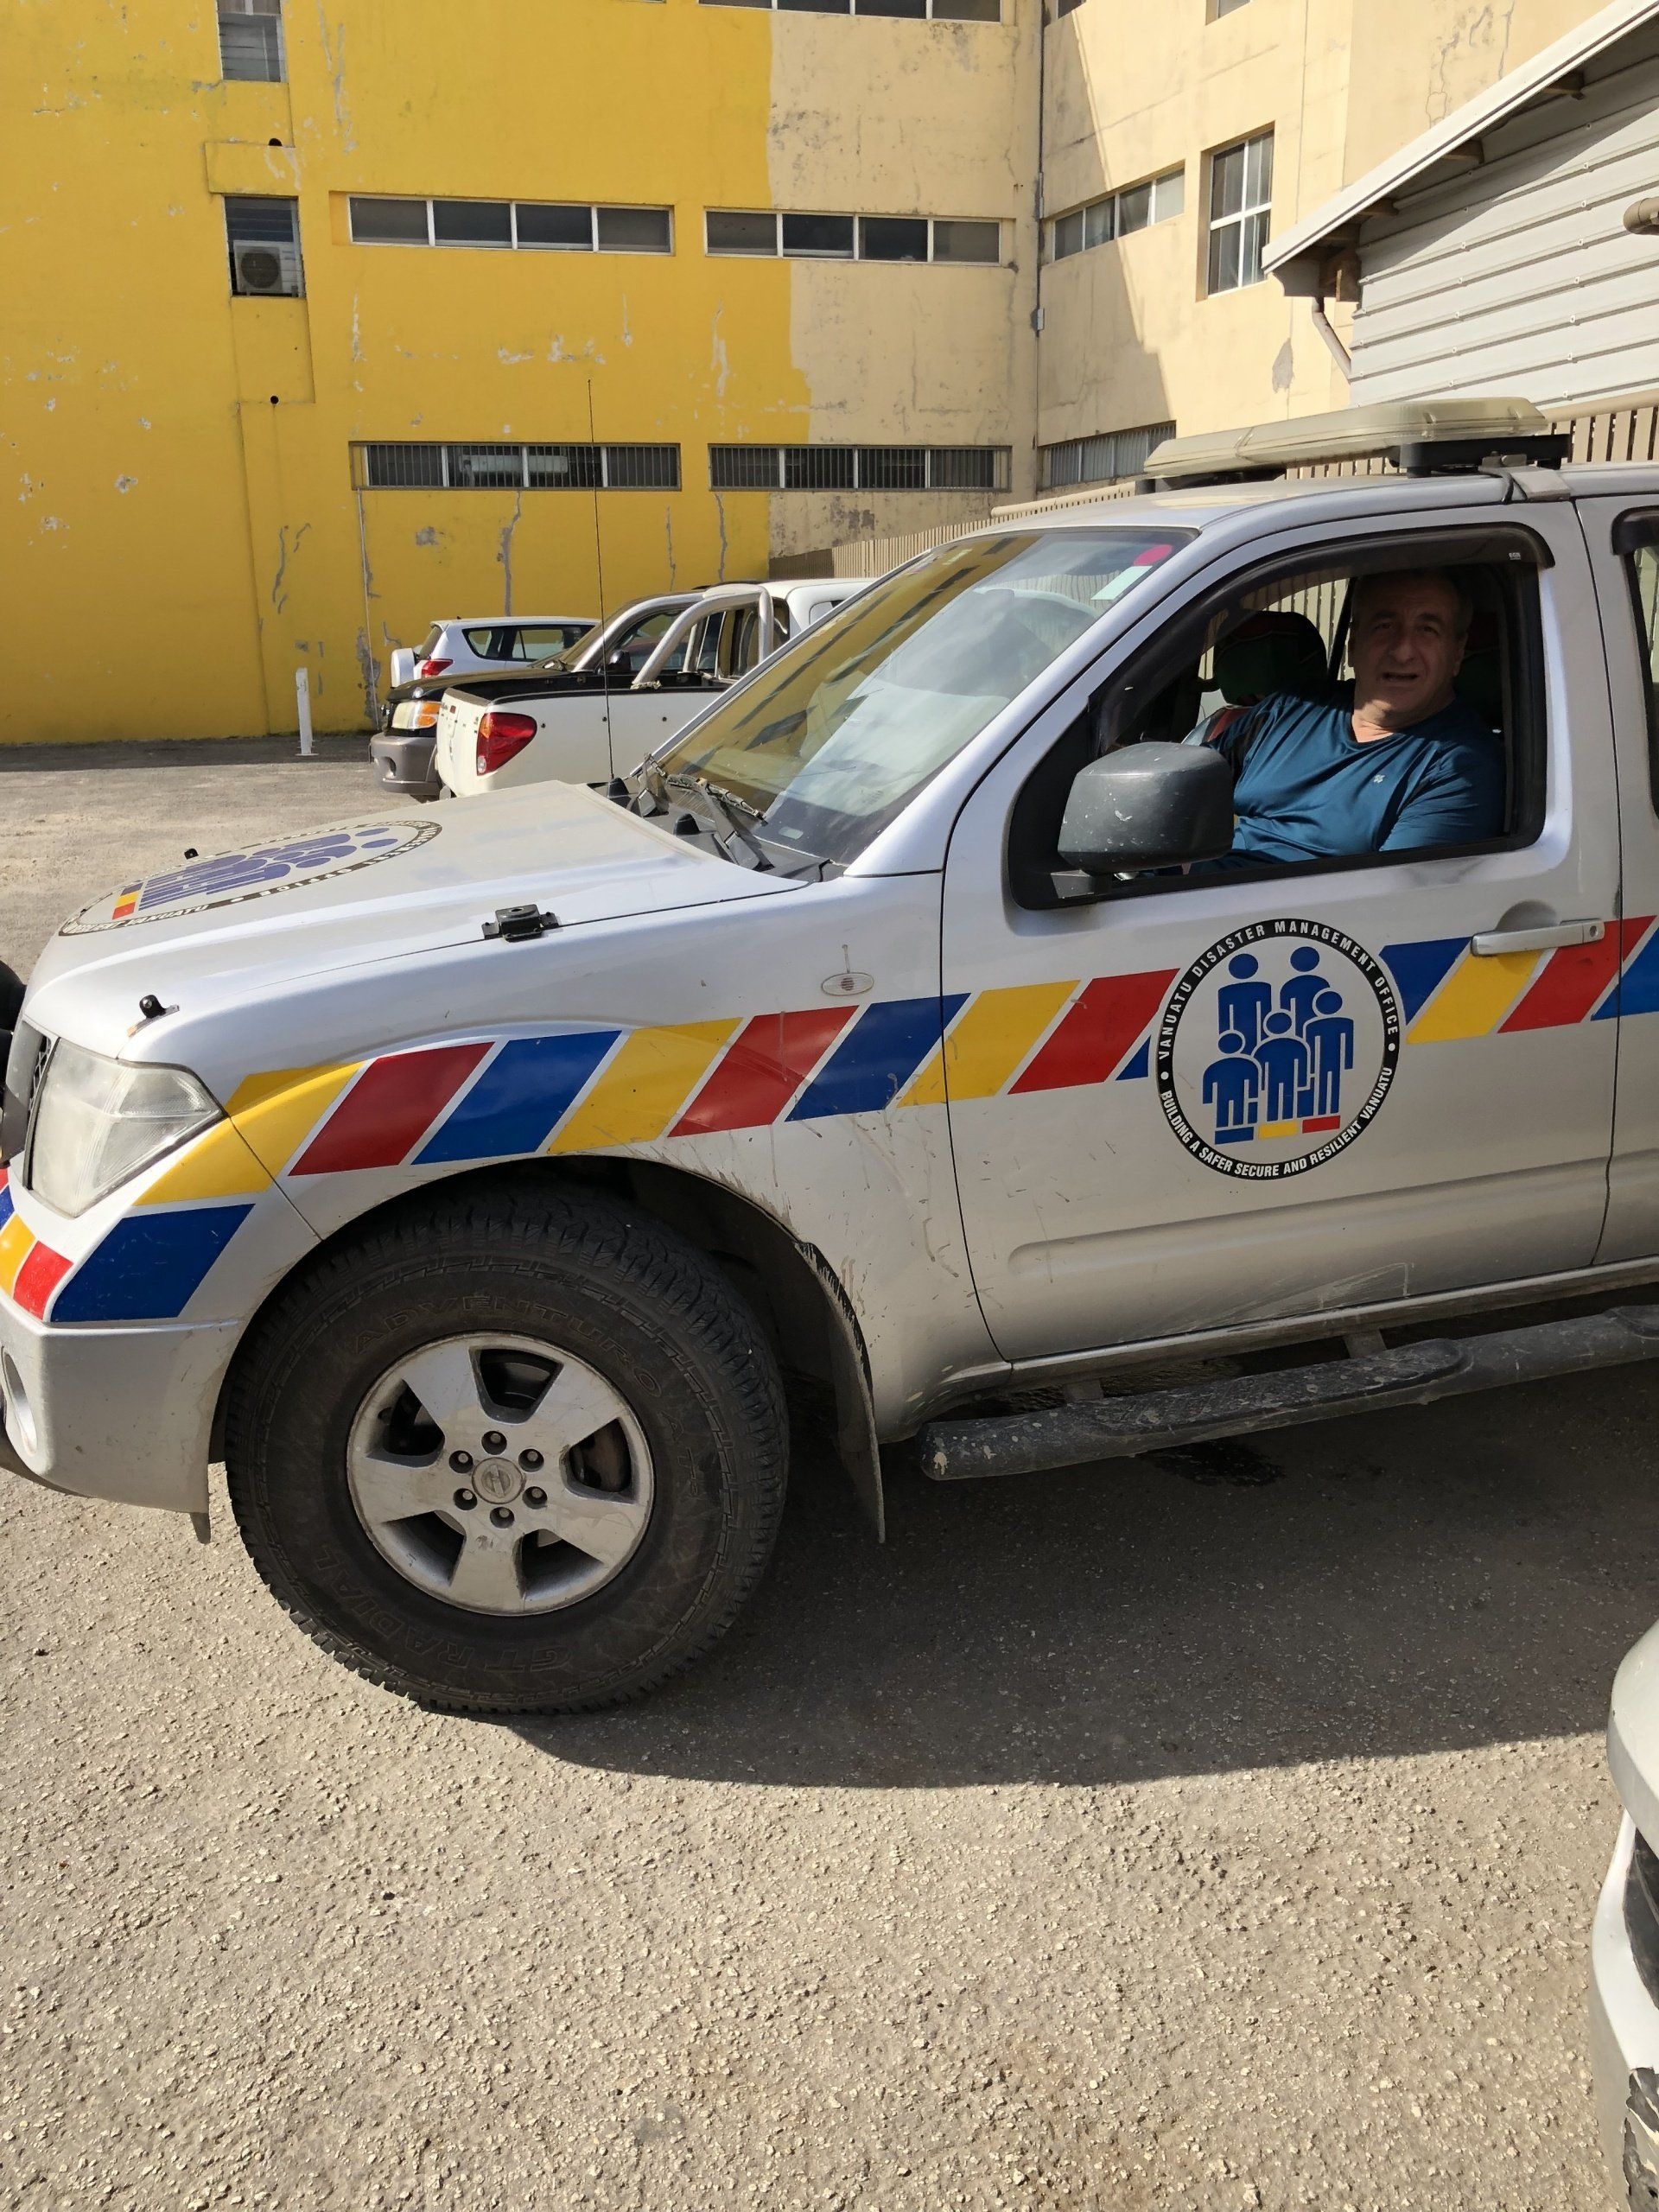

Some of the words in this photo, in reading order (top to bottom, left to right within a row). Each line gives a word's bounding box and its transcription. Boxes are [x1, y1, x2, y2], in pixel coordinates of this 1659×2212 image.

[1159, 982, 1192, 1060] VANUATU
[1192, 924, 1265, 978] DISASTER
[1274, 920, 1376, 973] MANAGEMENT
[1375, 976, 1399, 1034] OFFICE
[1160, 1090, 1191, 1144] BUILDING
[1189, 1141, 1198, 1153] A
[1198, 1147, 1233, 1173] SAFER
[1234, 1162, 1280, 1177] SECURE
[1283, 1157, 1307, 1175] AND
[1309, 1122, 1363, 1166] RESILIENT
[1359, 1066, 1393, 1120] VANUATU
